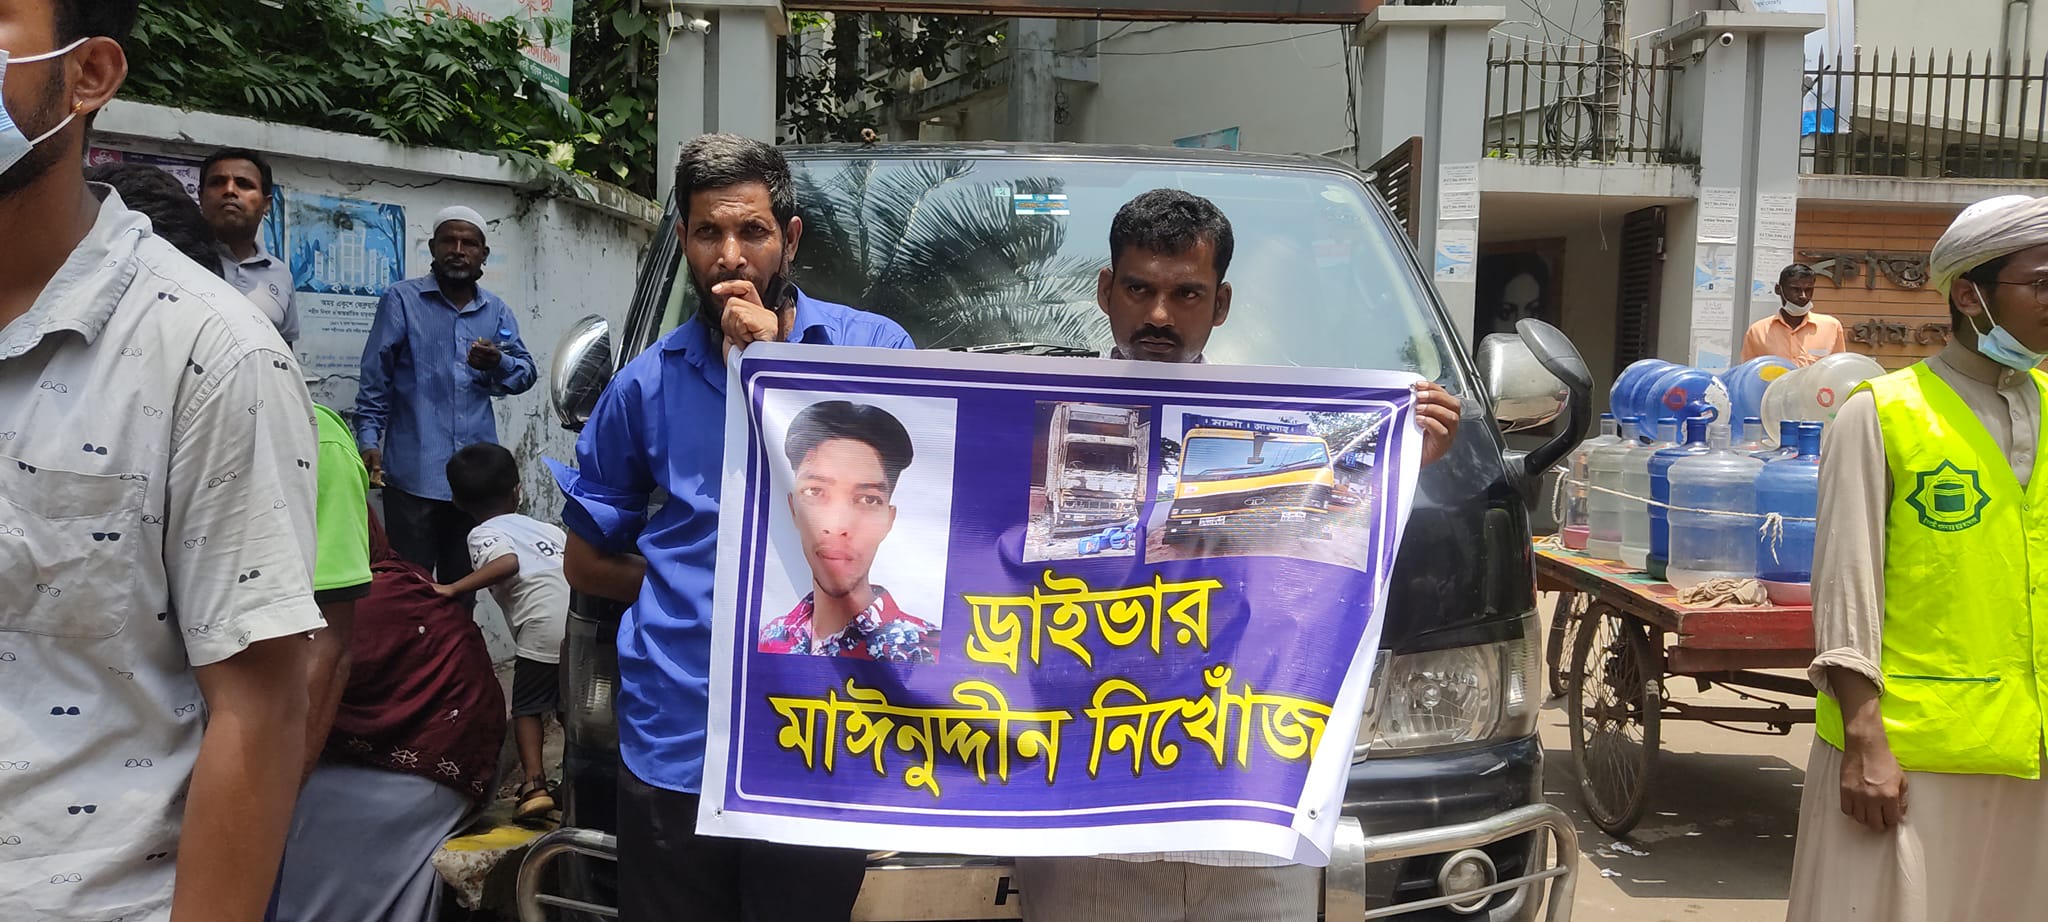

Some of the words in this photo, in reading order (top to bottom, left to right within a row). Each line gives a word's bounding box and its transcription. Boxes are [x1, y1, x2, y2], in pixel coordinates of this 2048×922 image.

[964, 570, 1222, 674] ড্রাইভার
[768, 678, 1072, 797] মাঈনুদ্দীন
[1085, 666, 1334, 778] নিখোঁজ
